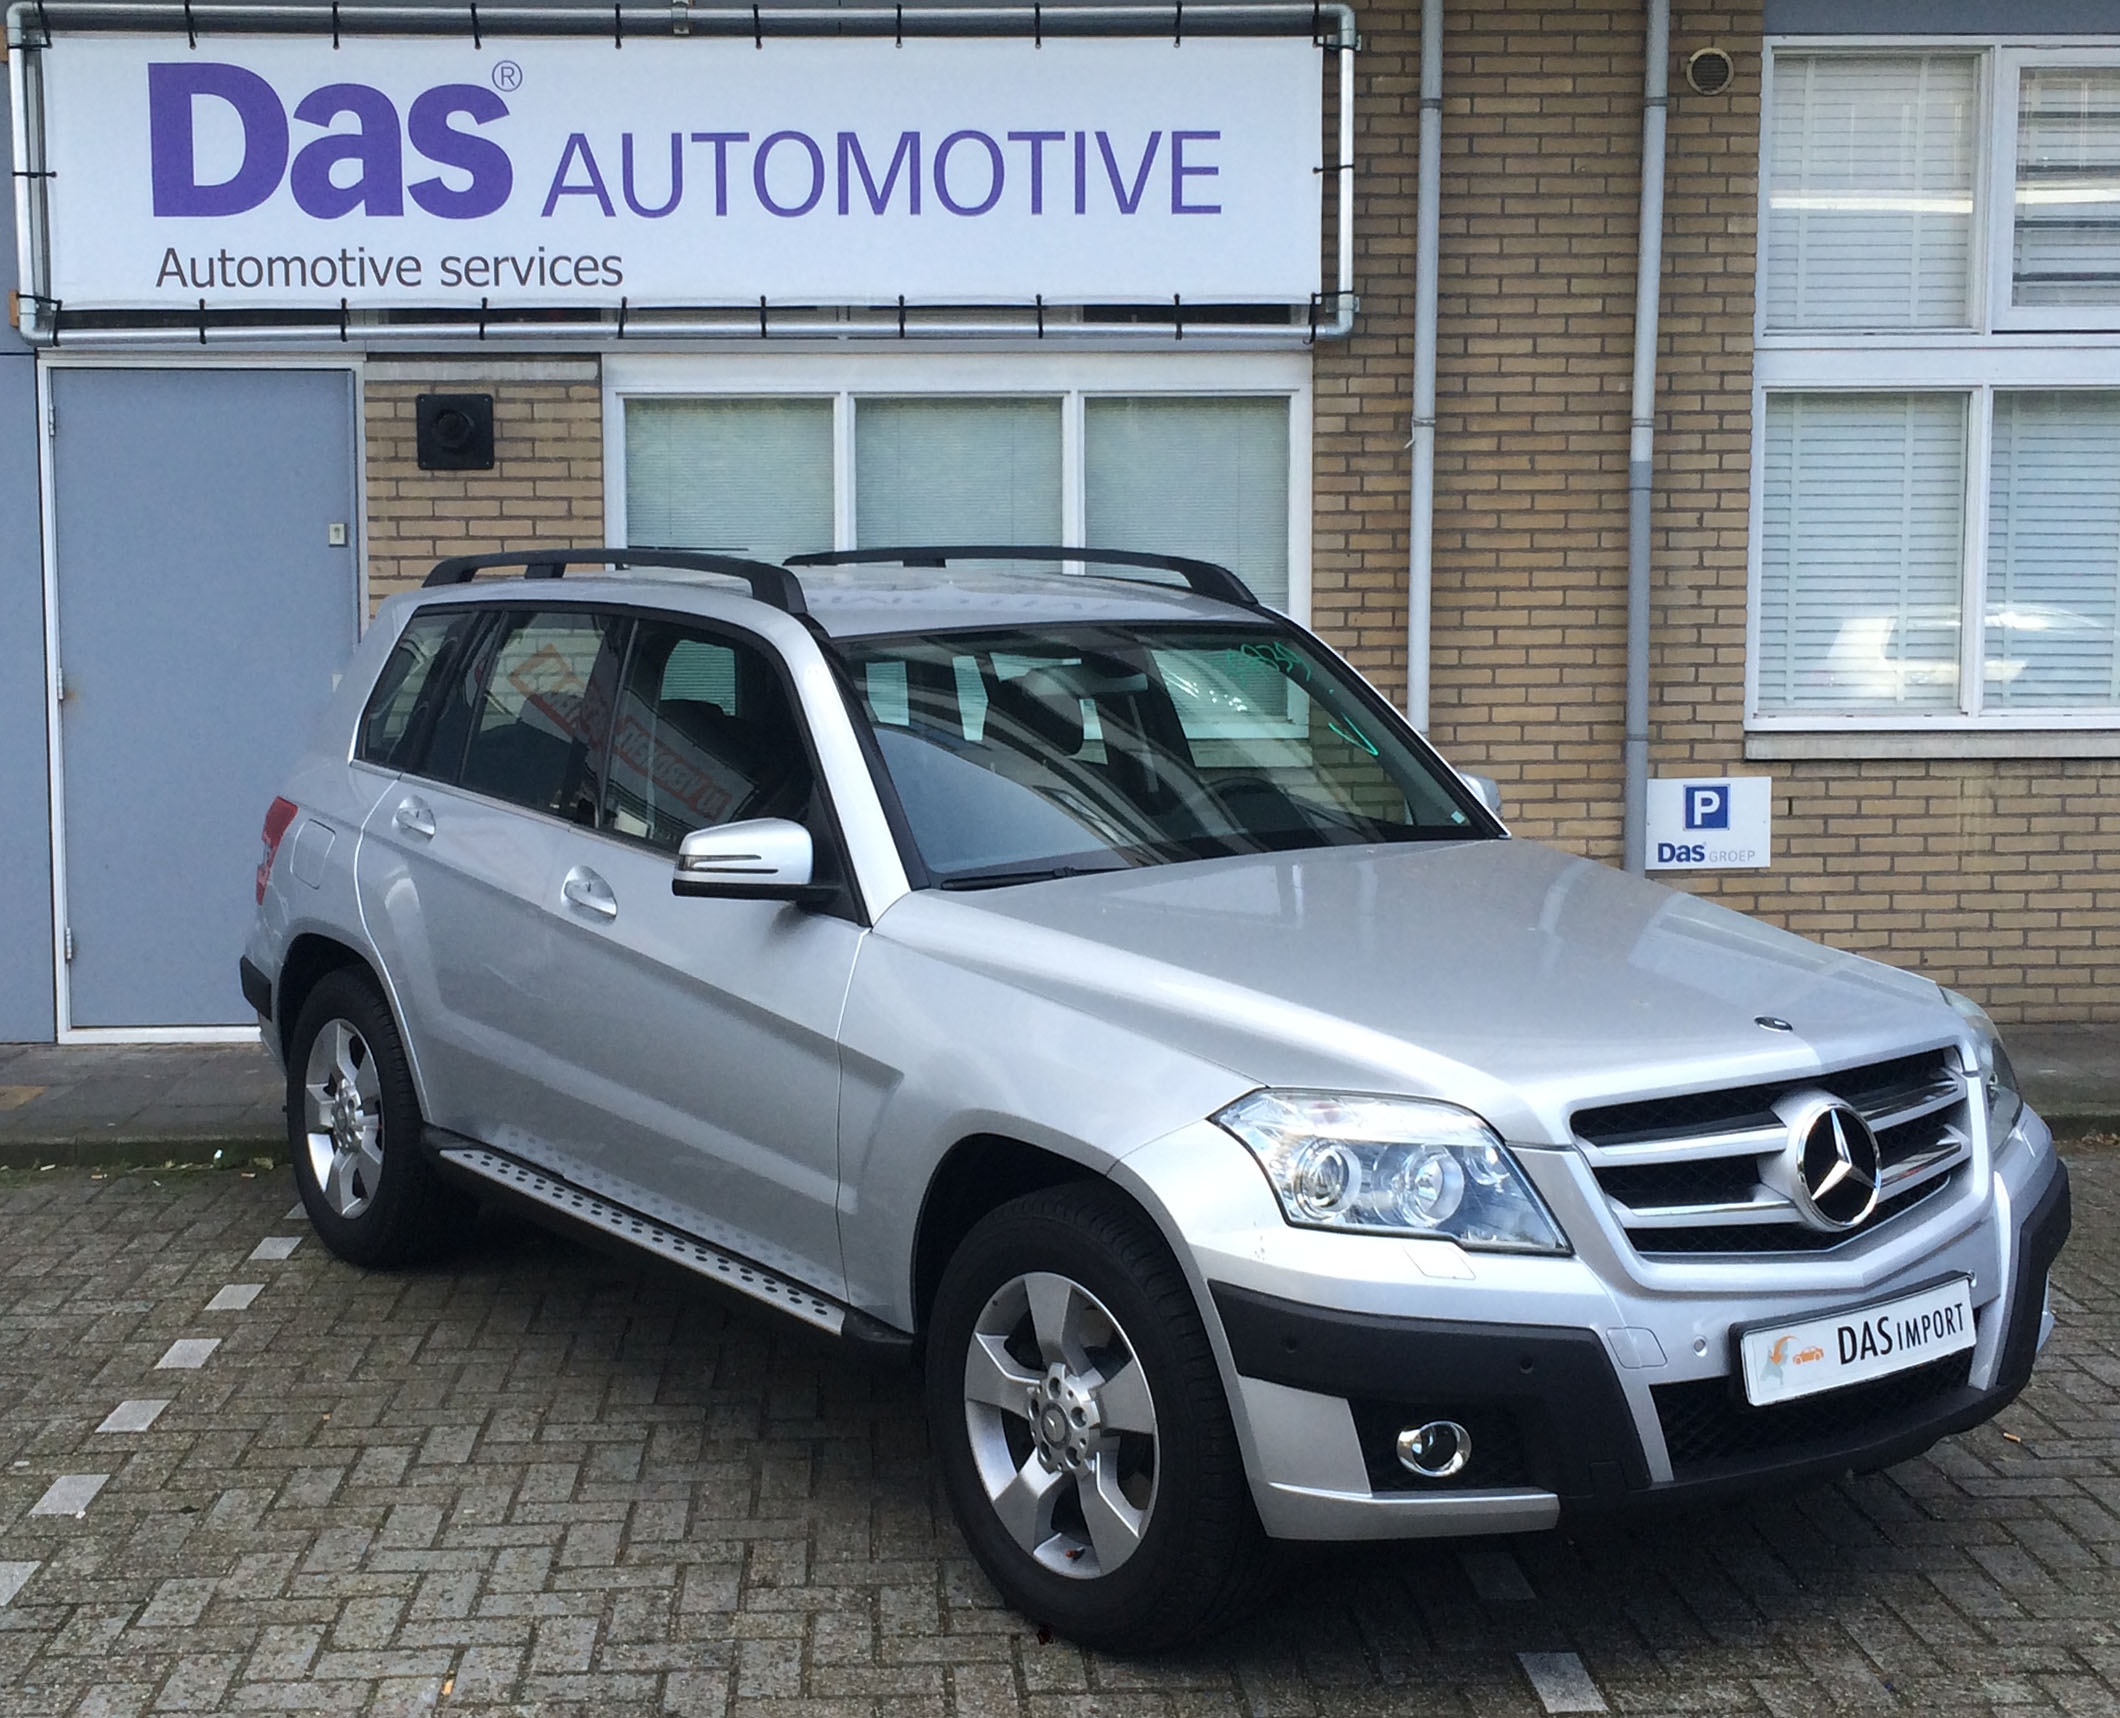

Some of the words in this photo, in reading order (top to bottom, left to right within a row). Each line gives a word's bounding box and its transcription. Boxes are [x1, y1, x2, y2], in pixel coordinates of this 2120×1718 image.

[541, 129, 1222, 218] AUTOMOTIVE
[156, 247, 421, 288] Automotive
[441, 247, 624, 287] services
[1693, 790, 1721, 826] P
[1657, 842, 1705, 863] Das
[1708, 849, 1756, 863] GROEP
[1837, 1315, 1893, 1365] DAS
[1896, 1303, 1964, 1351] IMPORT
